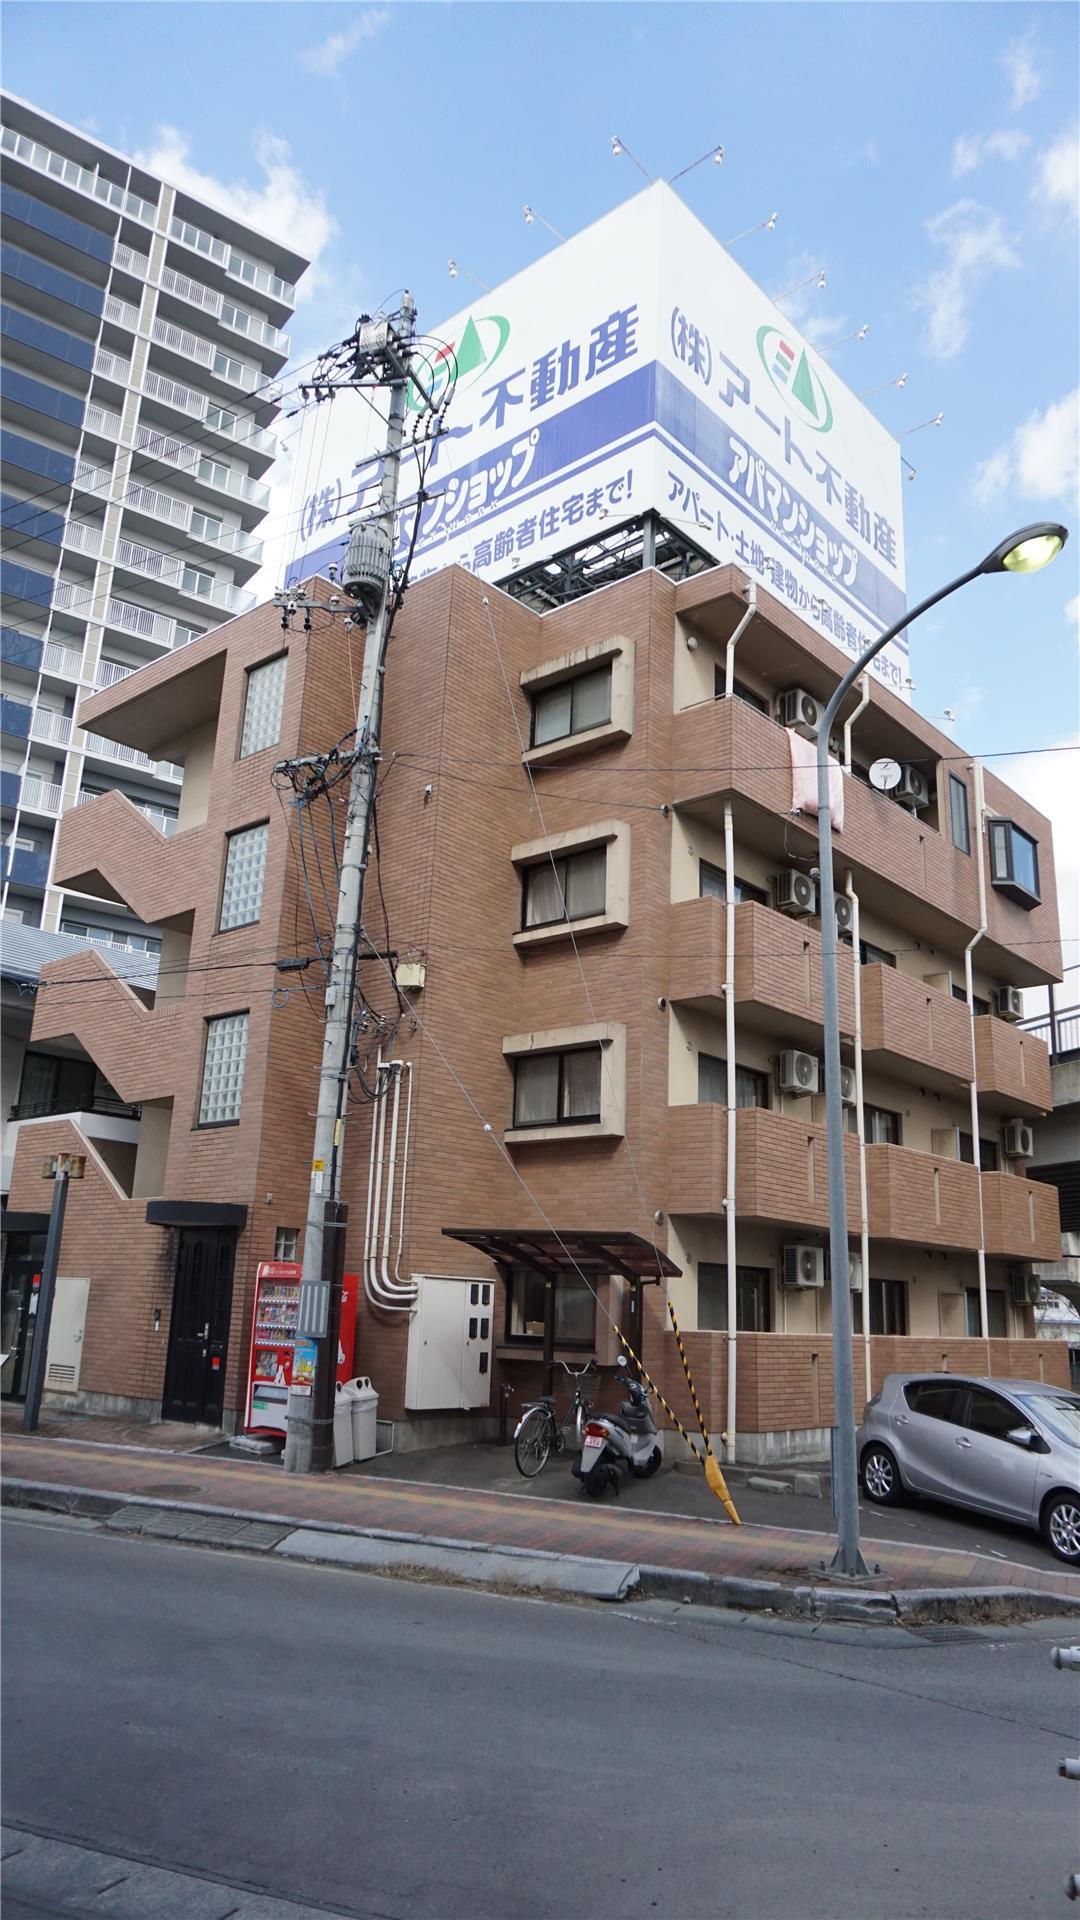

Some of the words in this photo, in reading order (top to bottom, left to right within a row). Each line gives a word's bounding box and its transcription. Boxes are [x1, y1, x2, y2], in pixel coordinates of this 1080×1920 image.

[671, 306, 896, 570] (株)アート不動産
[728, 436, 858, 587] アパマンショップ
